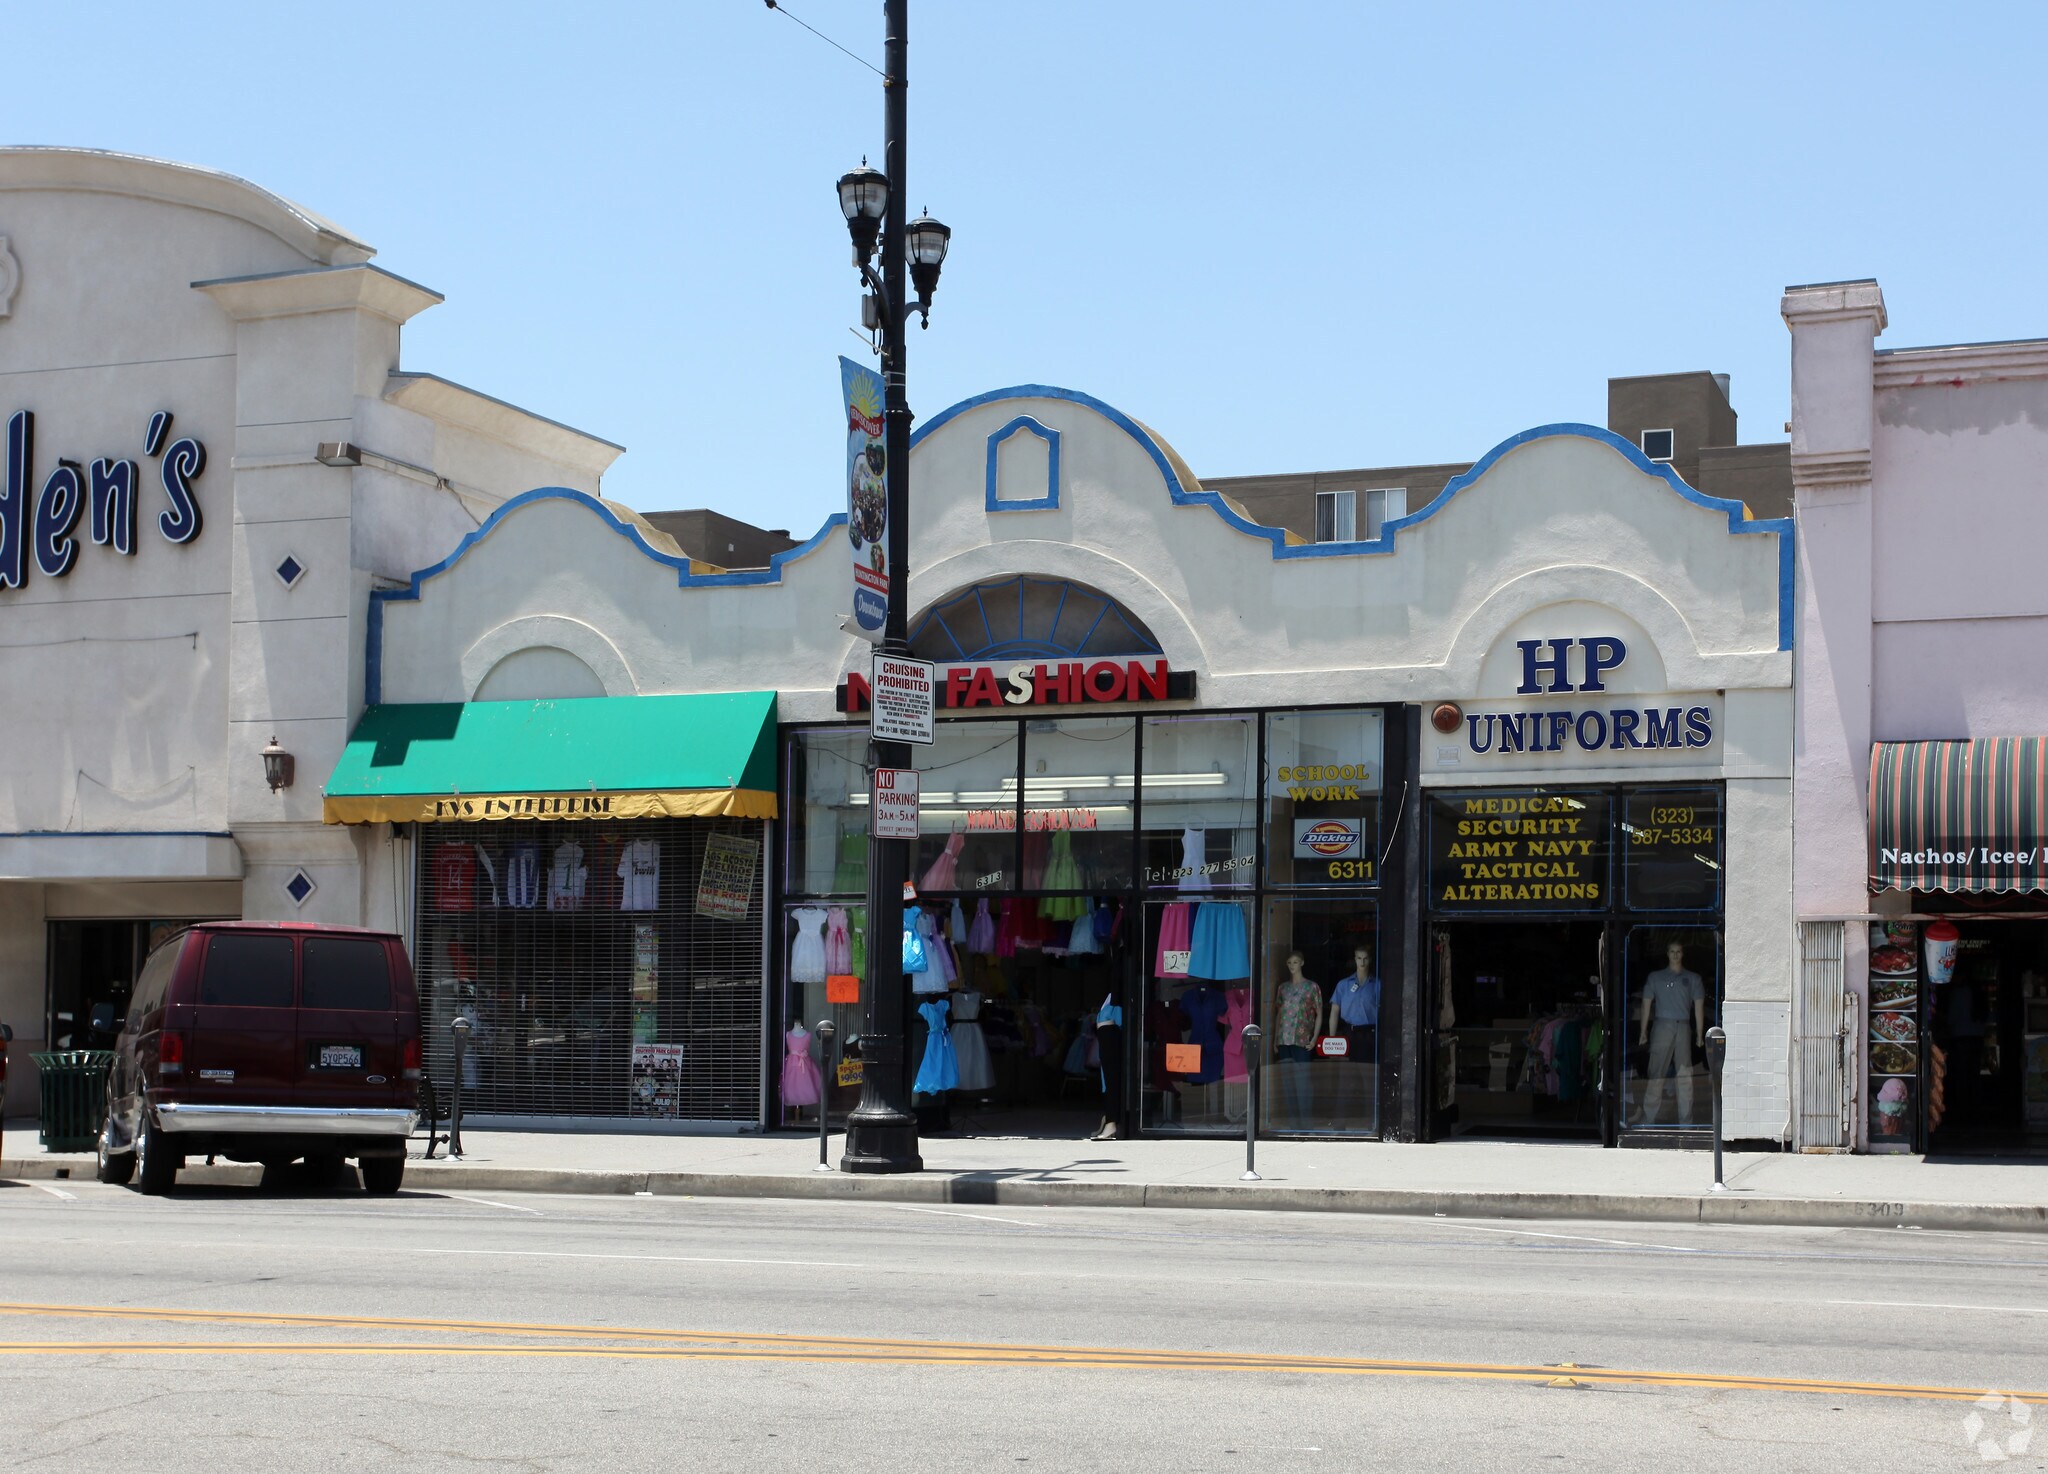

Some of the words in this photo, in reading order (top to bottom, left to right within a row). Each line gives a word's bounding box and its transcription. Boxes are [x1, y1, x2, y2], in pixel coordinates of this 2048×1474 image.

[851, 408, 881, 434] REDISCOVER
[883, 662, 925, 678] CRUISING
[1516, 636, 1627, 696] HP
[878, 674, 929, 692] PROHIBITED
[946, 659, 1168, 708] FASHION
[1466, 706, 1712, 754] UNIFORMS
[879, 771, 892, 787] NO
[1278, 764, 1369, 783] SCHOOL
[880, 792, 916, 806] PARKING
[1286, 784, 1360, 802] WORK
[437, 801, 473, 816] KVS
[485, 797, 614, 814] ENTERPRISE
[1465, 797, 1576, 814] MEDICAL
[1650, 806, 1694, 825] (323)
[1458, 818, 1582, 836] SECURITY
[1306, 834, 1353, 842] Dickies
[1632, 828, 1713, 846] 587-5334
[1448, 840, 1518, 858] ARMY
[1528, 839, 1594, 857] NAVY
[1881, 847, 1975, 865] Nachos/
[1980, 847, 2037, 865] Icee/
[1173, 867, 1193, 878] 323
[1200, 863, 1219, 875] 277
[1224, 859, 1237, 870] 55
[1240, 856, 1254, 866] 04
[1328, 861, 1372, 879] 6311
[1461, 862, 1580, 879] TACTICAL
[562, 864, 571, 890] 1
[977, 872, 1001, 887] 6313
[1442, 883, 1599, 900] ALTERATIONS
